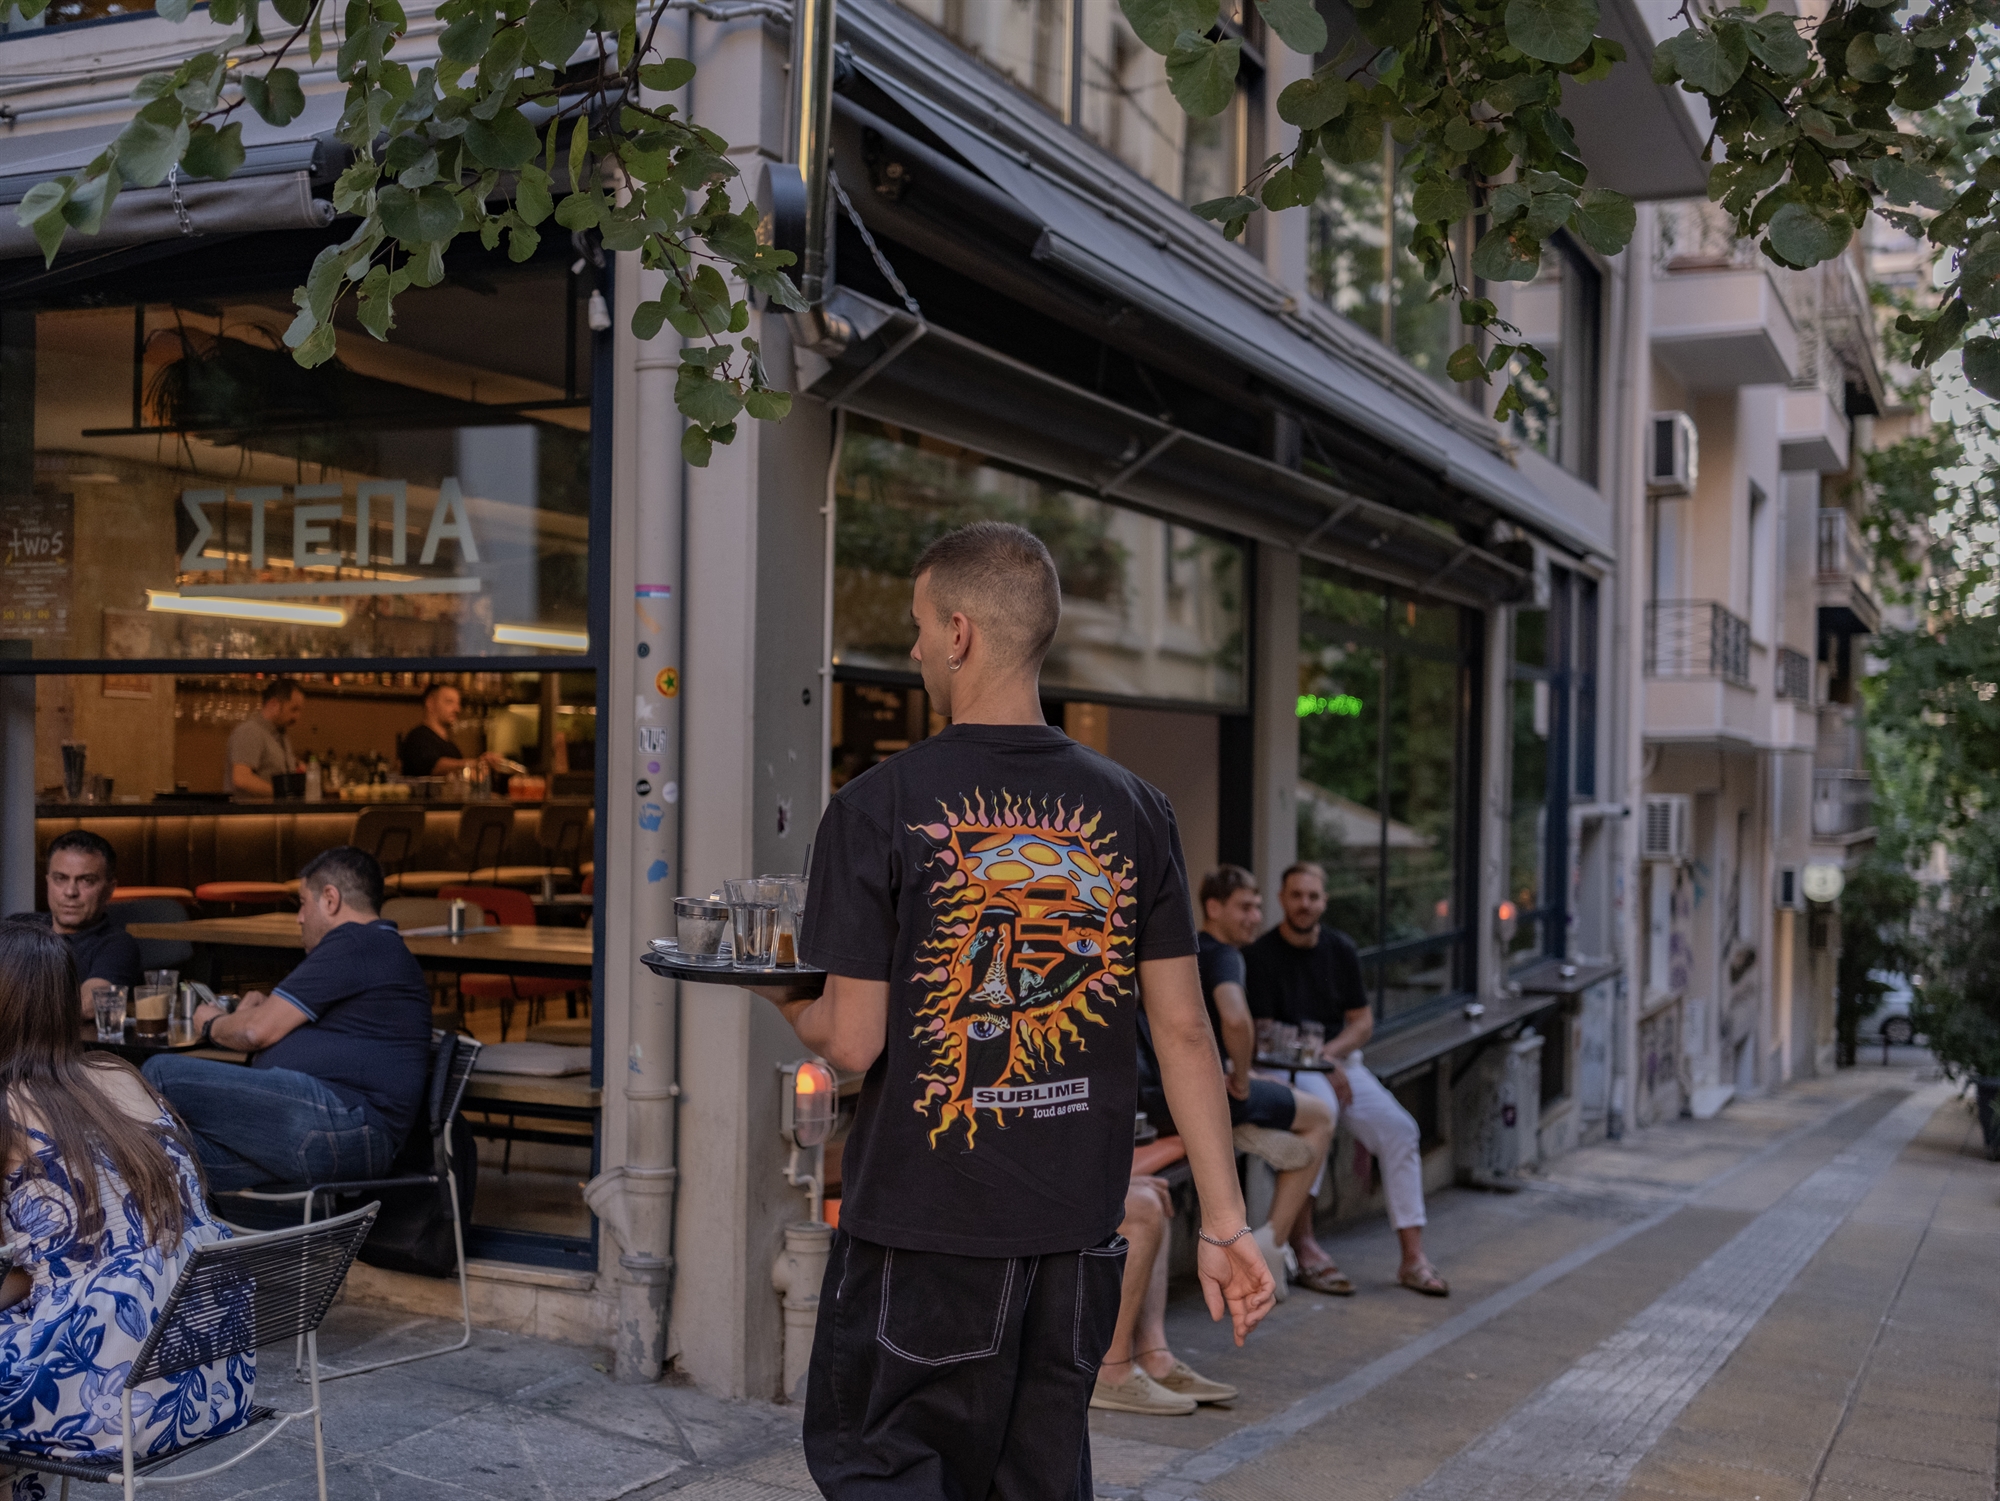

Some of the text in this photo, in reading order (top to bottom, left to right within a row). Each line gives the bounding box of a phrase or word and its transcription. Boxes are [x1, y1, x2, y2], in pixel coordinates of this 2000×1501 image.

[180, 477, 480, 571] ΣΤΕΠΑ
[976, 1082, 1085, 1103] SUBLIME
[1033, 1102, 1089, 1119] loud as ever.
